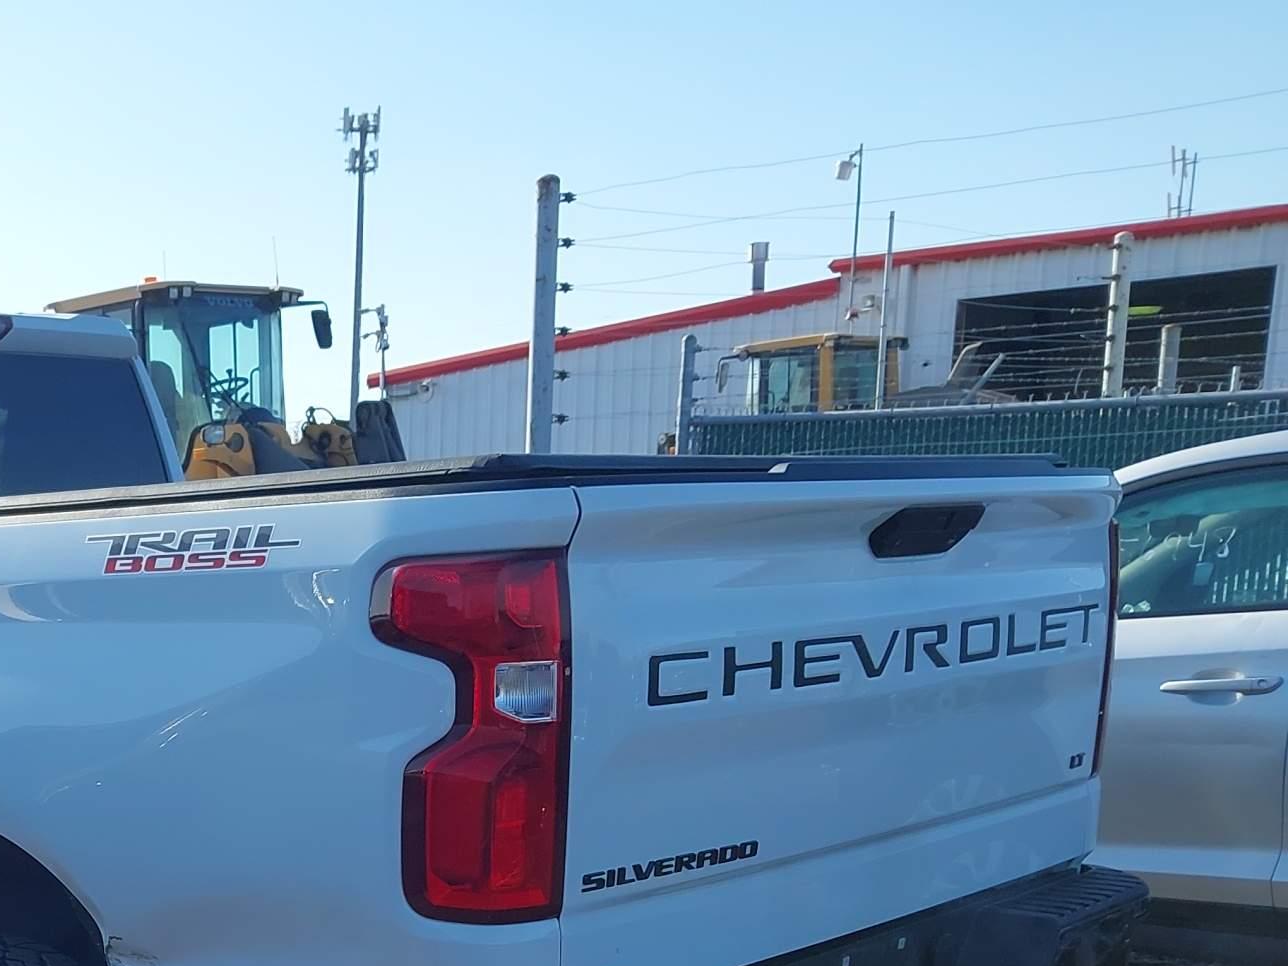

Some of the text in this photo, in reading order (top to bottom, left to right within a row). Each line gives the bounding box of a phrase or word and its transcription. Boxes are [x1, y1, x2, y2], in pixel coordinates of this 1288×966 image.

[86, 524, 300, 556] TRAIL
[104, 549, 269, 574] BOSS
[646, 603, 1100, 707] CHEVROLET
[1069, 752, 1086, 770] LT
[580, 839, 760, 893] SILVERADO
